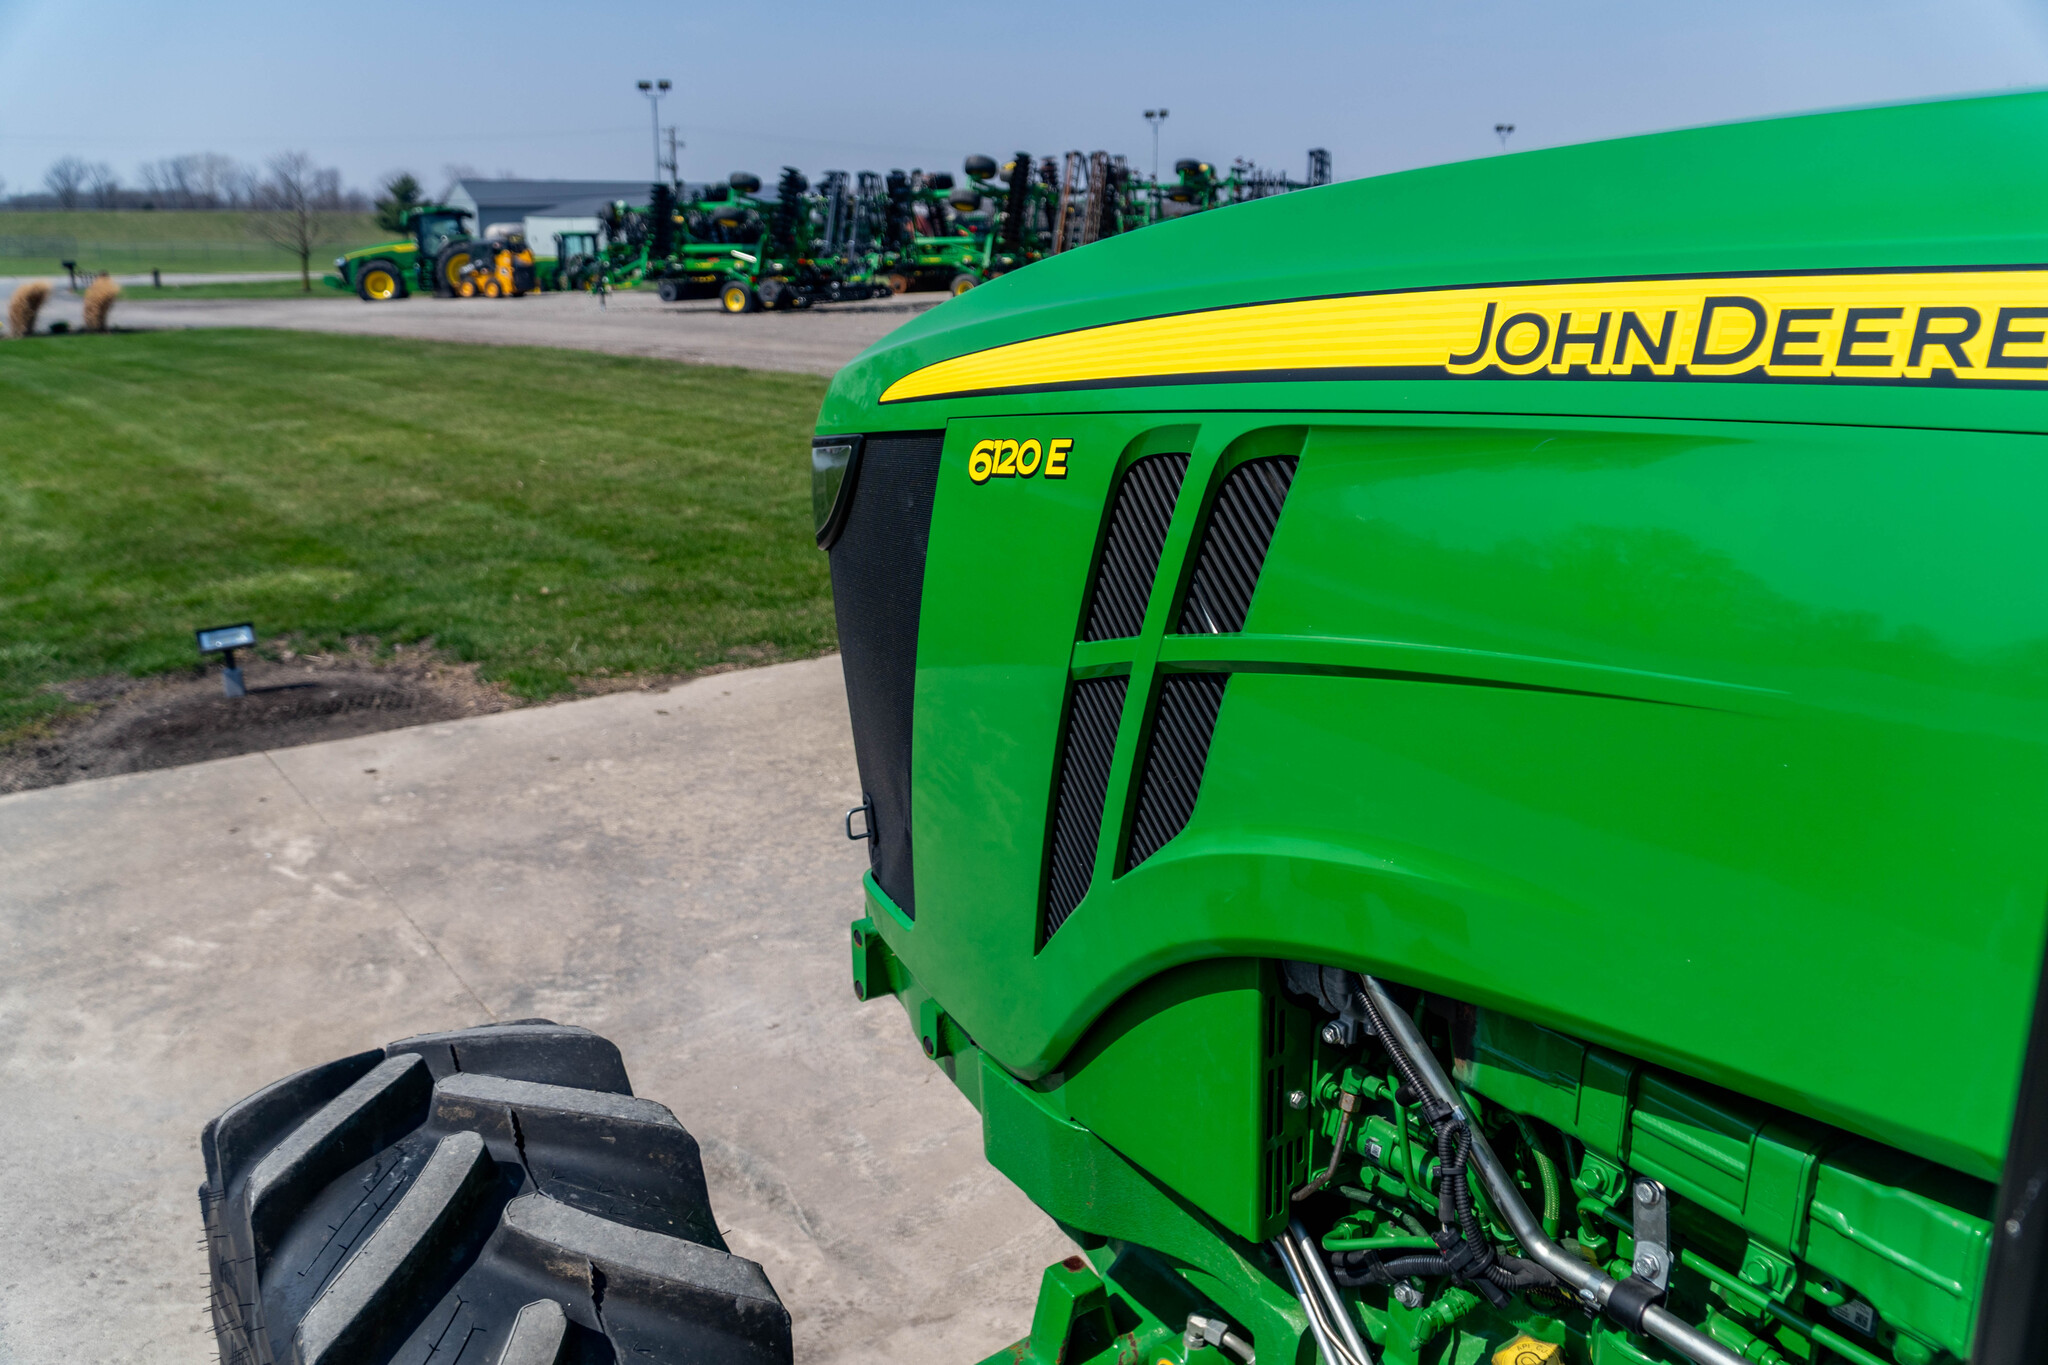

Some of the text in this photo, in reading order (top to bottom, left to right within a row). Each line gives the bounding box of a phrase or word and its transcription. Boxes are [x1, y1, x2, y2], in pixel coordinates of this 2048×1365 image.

[1448, 296, 2048, 369] JOHN DEERE
[968, 438, 1075, 486] 6120 E
